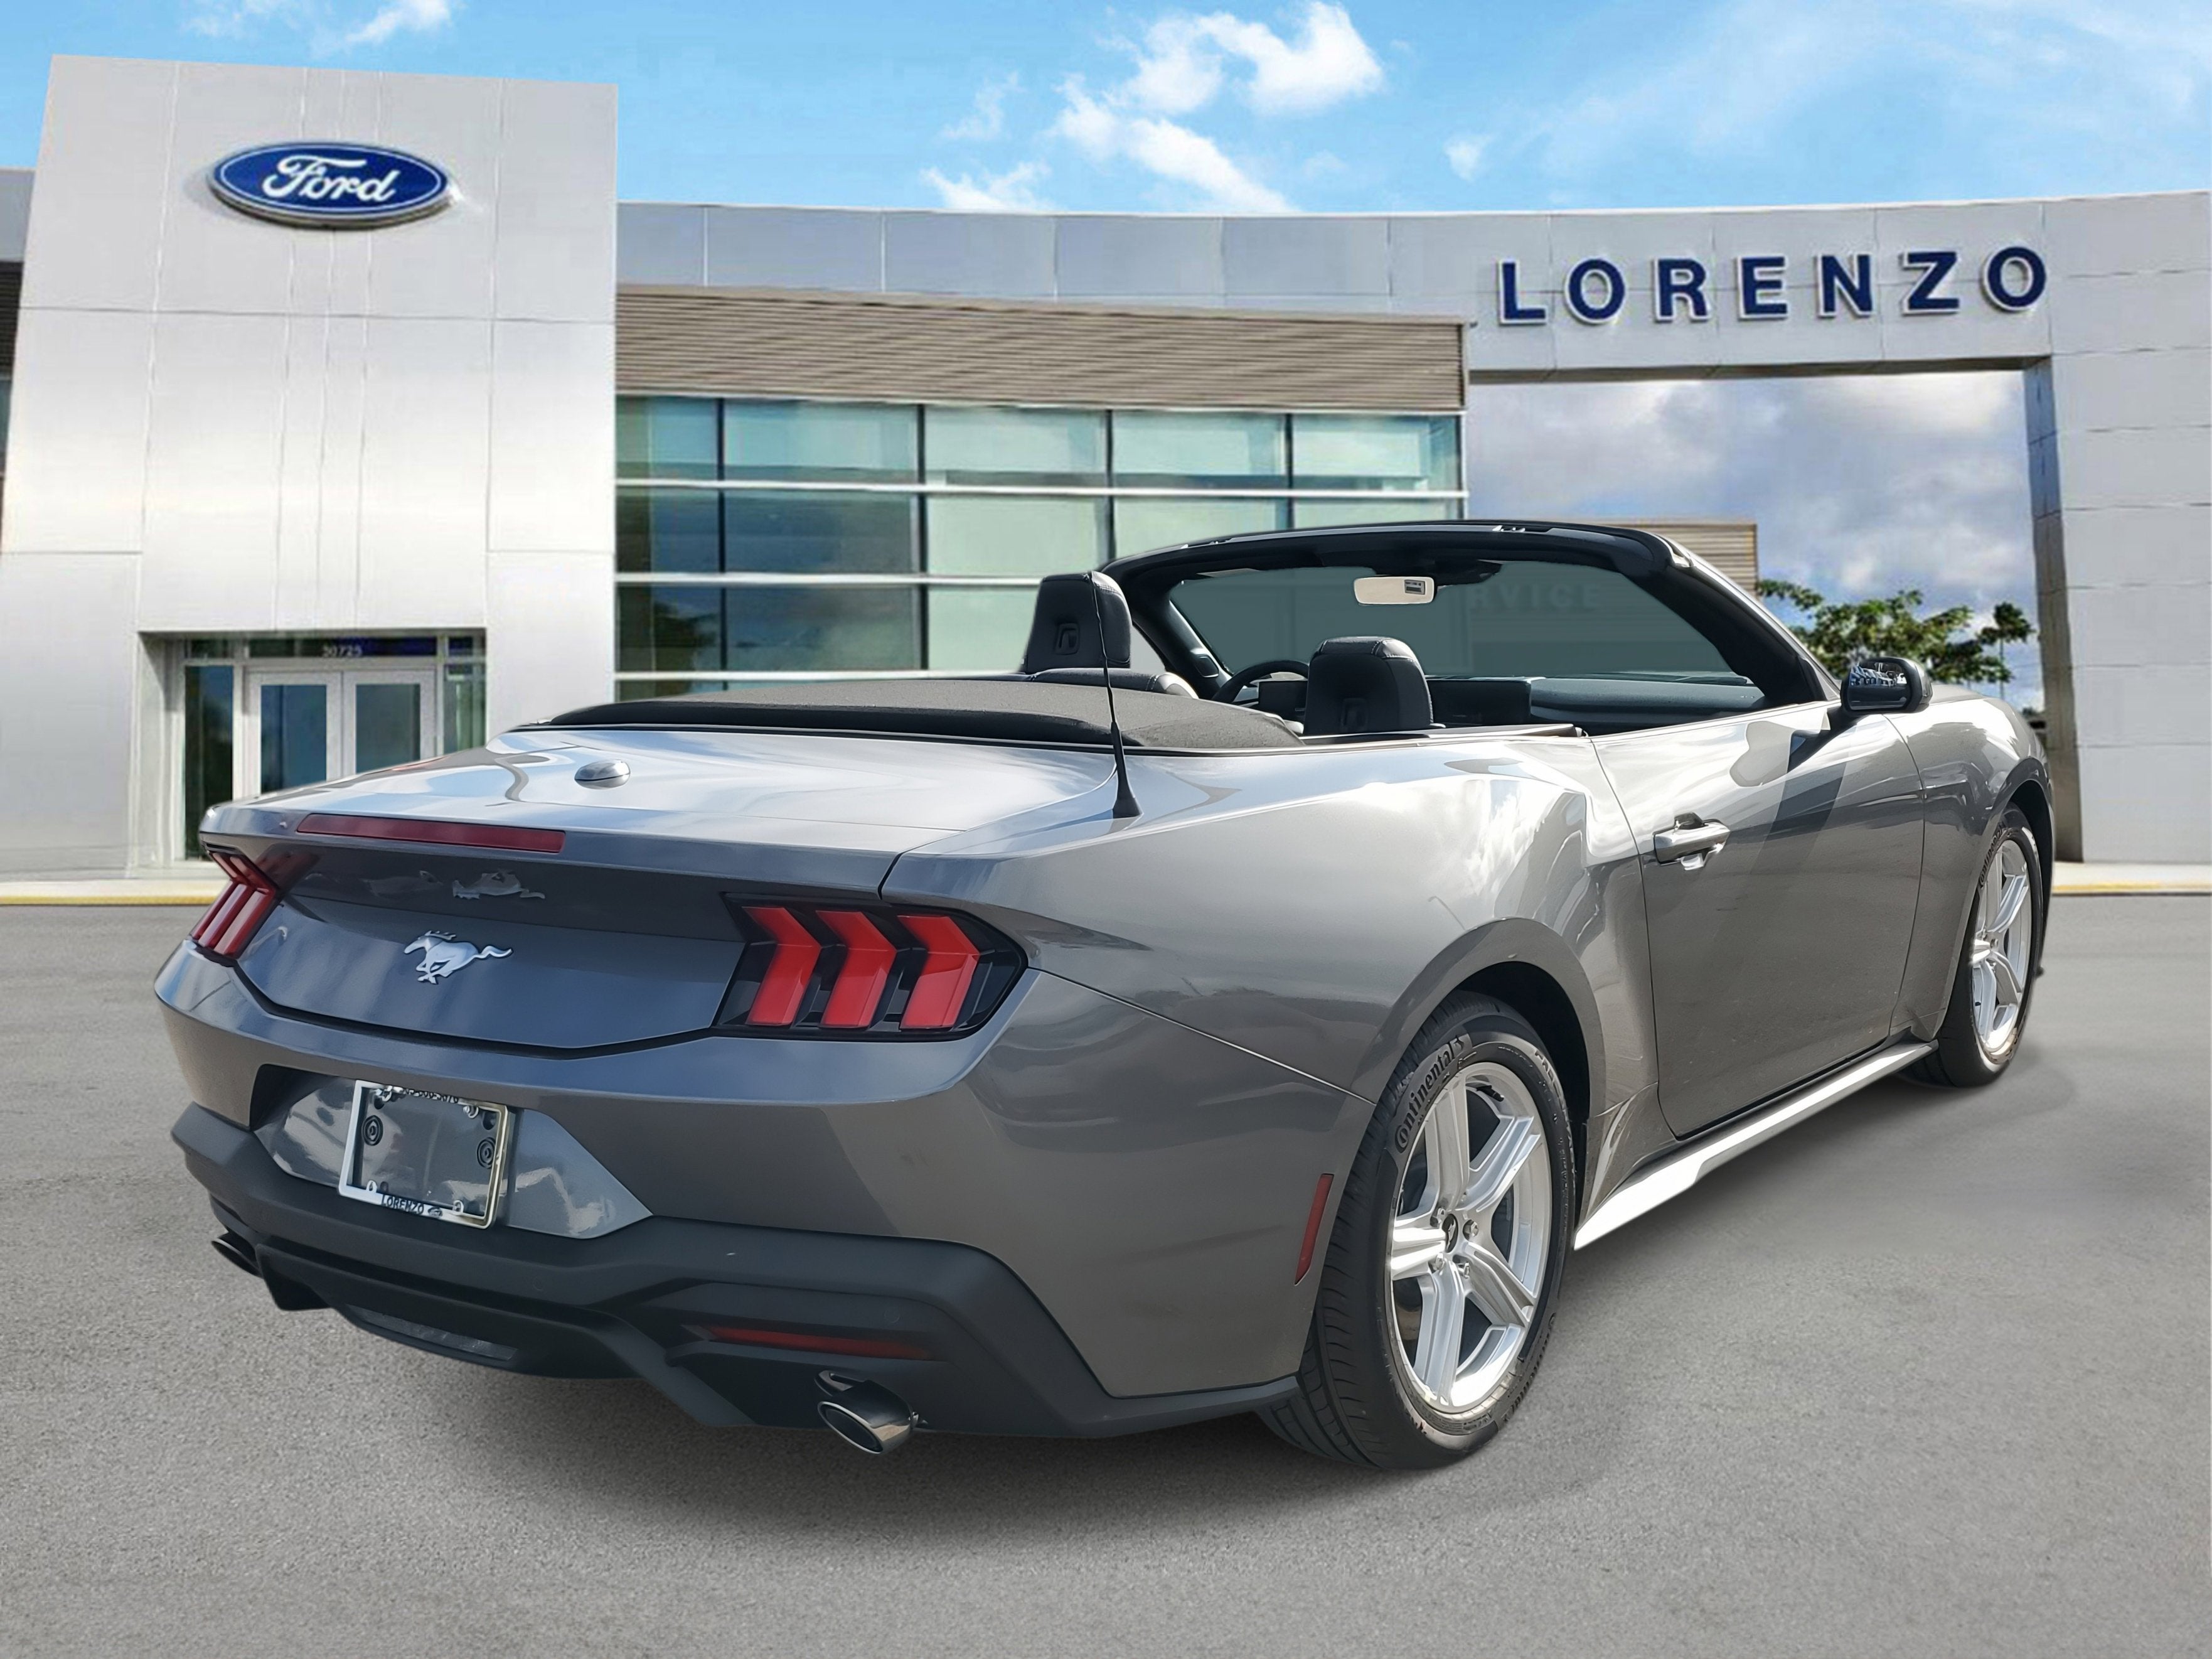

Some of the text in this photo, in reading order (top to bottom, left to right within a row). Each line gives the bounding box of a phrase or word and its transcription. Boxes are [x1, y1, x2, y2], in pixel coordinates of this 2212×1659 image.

[262, 154, 401, 201] Ford
[1497, 246, 2048, 325] LORENZO
[1394, 1041, 1456, 1154] Continental
[381, 1194, 425, 1216] LORENZO
